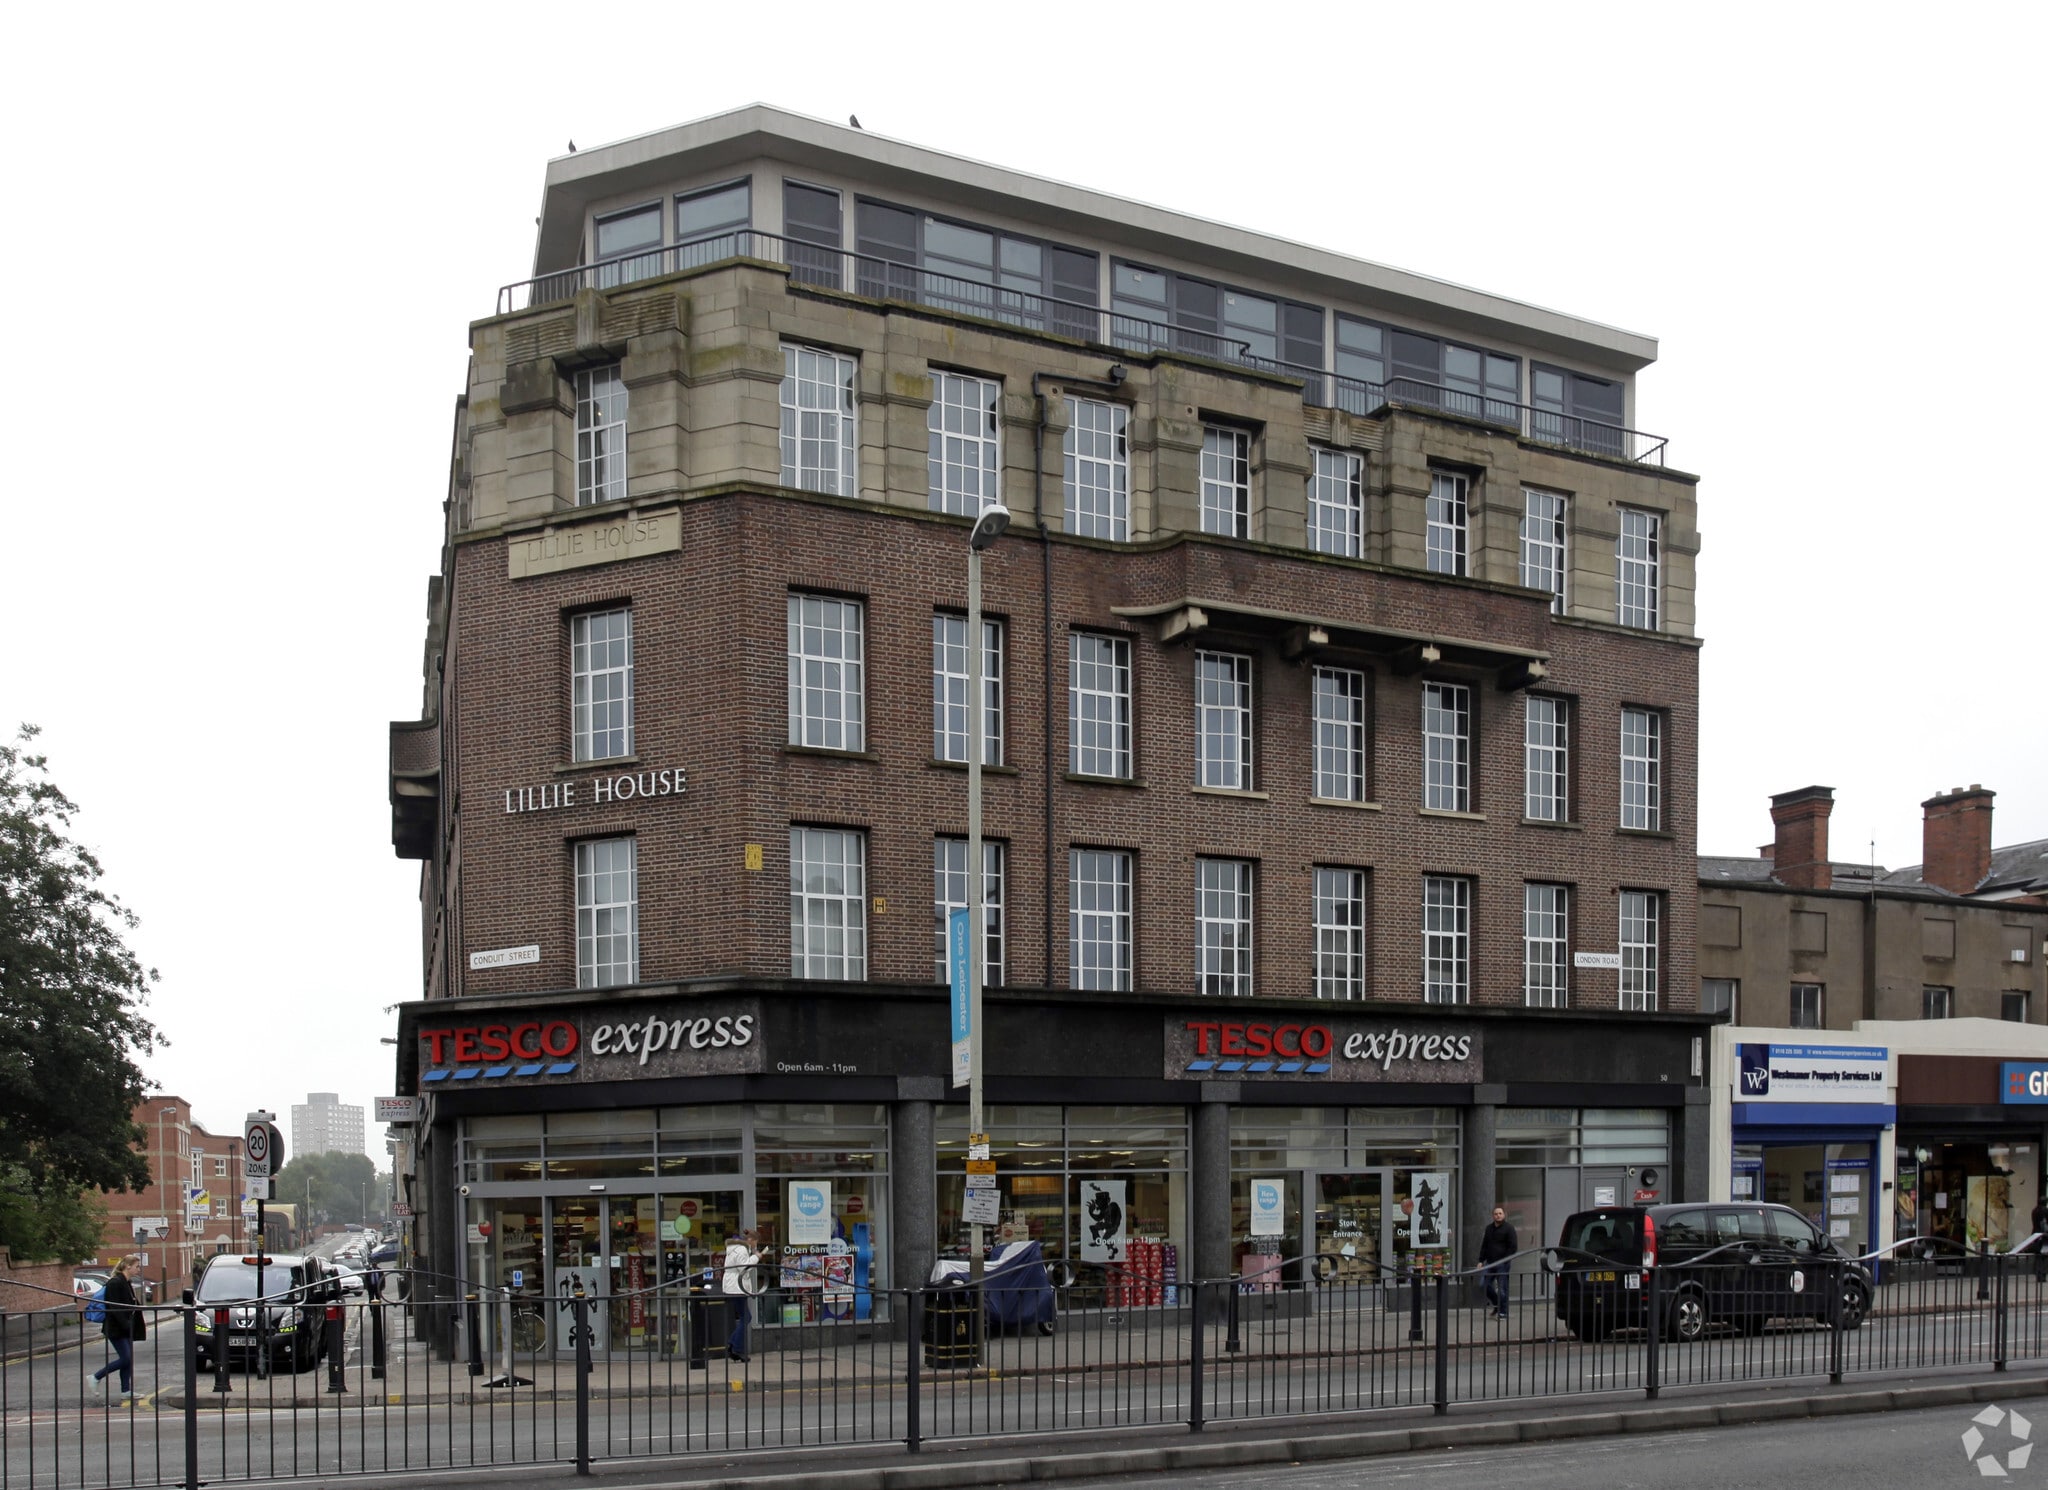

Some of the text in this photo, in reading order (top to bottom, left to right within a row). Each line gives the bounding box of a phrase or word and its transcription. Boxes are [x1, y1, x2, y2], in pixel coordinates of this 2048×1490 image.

[527, 519, 660, 562] LILLIE HOUSE
[505, 768, 687, 813] LILLIE HOUSE
[473, 949, 537, 965] CONDUIT STREET
[1576, 955, 1619, 965] LONDON ROAD
[957, 922, 967, 1032] One Leicester
[420, 1014, 754, 1066] TESCO express
[1186, 1021, 1472, 1071] TESCO express
[776, 1061, 802, 1073] Open
[803, 1062, 824, 1072] 6am
[832, 1063, 857, 1074] 11pm
[1771, 1069, 1882, 1082] Westmanor Property Services Ltd
[380, 1099, 412, 1118] TESCO express
[250, 1135, 265, 1151] 20
[248, 1163, 268, 1174] ZONE
[801, 1193, 819, 1202] New
[1261, 1190, 1275, 1198] New
[799, 1201, 822, 1209] range
[1338, 1219, 1357, 1228] Store
[1139, 1236, 1161, 1245] 11pm
[1333, 1230, 1363, 1239] Entrance
[783, 1245, 808, 1256] Open
[809, 1245, 828, 1254] 6am
[632, 1294, 643, 1324] Offers
